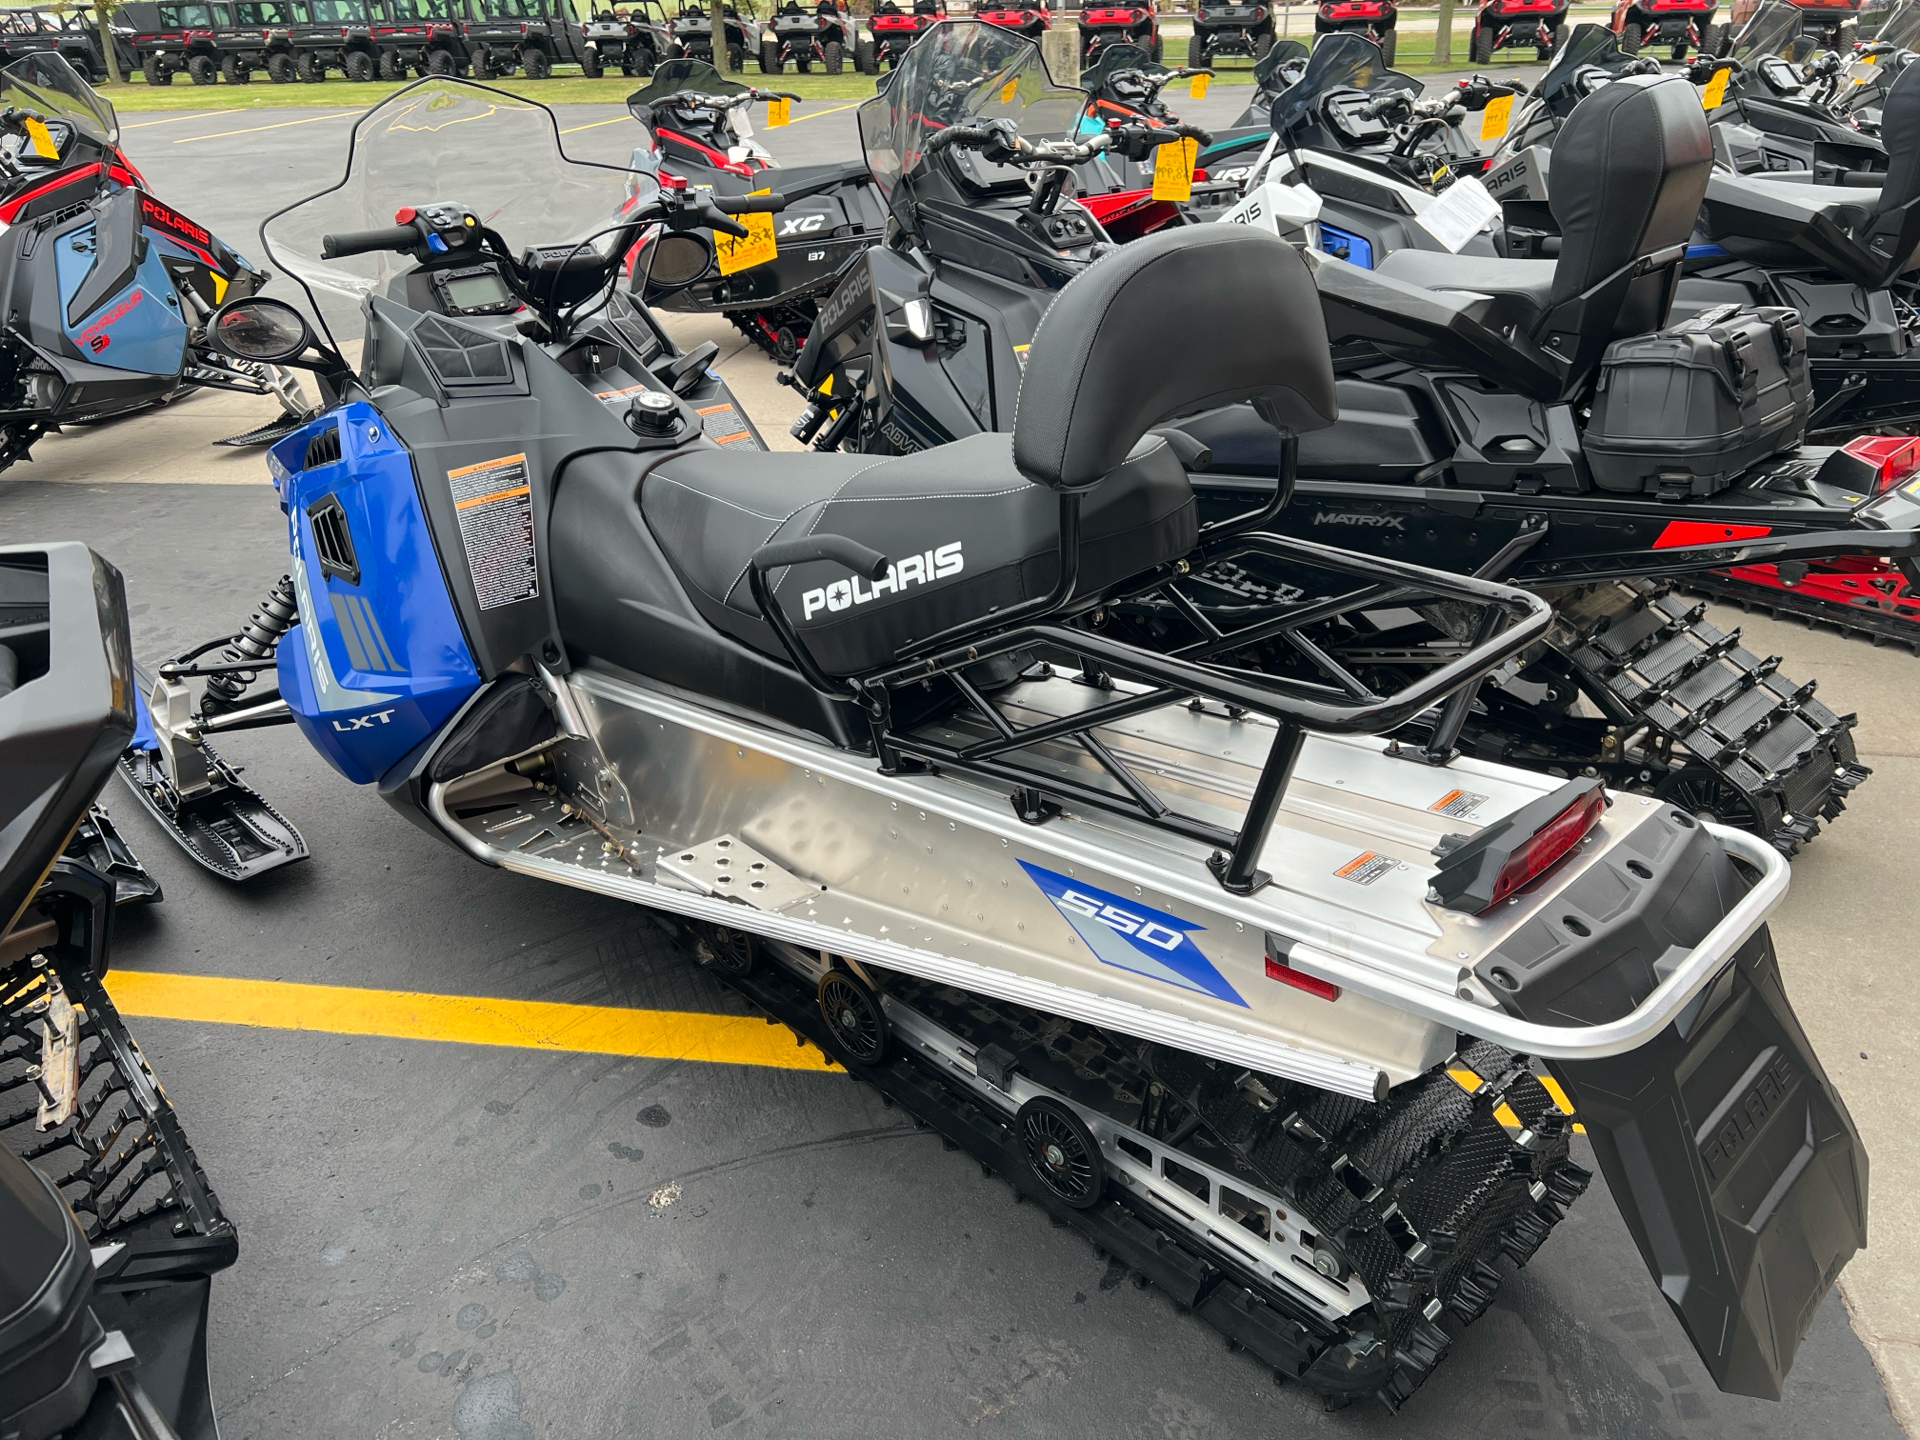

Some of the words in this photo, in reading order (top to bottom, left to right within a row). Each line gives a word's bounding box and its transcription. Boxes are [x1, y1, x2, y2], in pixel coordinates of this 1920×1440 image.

[1486, 161, 1527, 193] ARIS
[142, 199, 209, 245] POLARIS
[778, 214, 825, 236] XC
[808, 251, 825, 261] 137
[73, 289, 143, 346] VOYAGEUR
[821, 267, 870, 334] POLARIS
[90, 334, 111, 355] S4
[1313, 512, 1406, 531] MATRYX
[291, 505, 330, 694] POLARIS
[802, 541, 964, 621] POLARIS
[332, 708, 395, 732] LXT
[1056, 890, 1184, 951] 550
[1703, 1053, 1793, 1180] POLARIS
